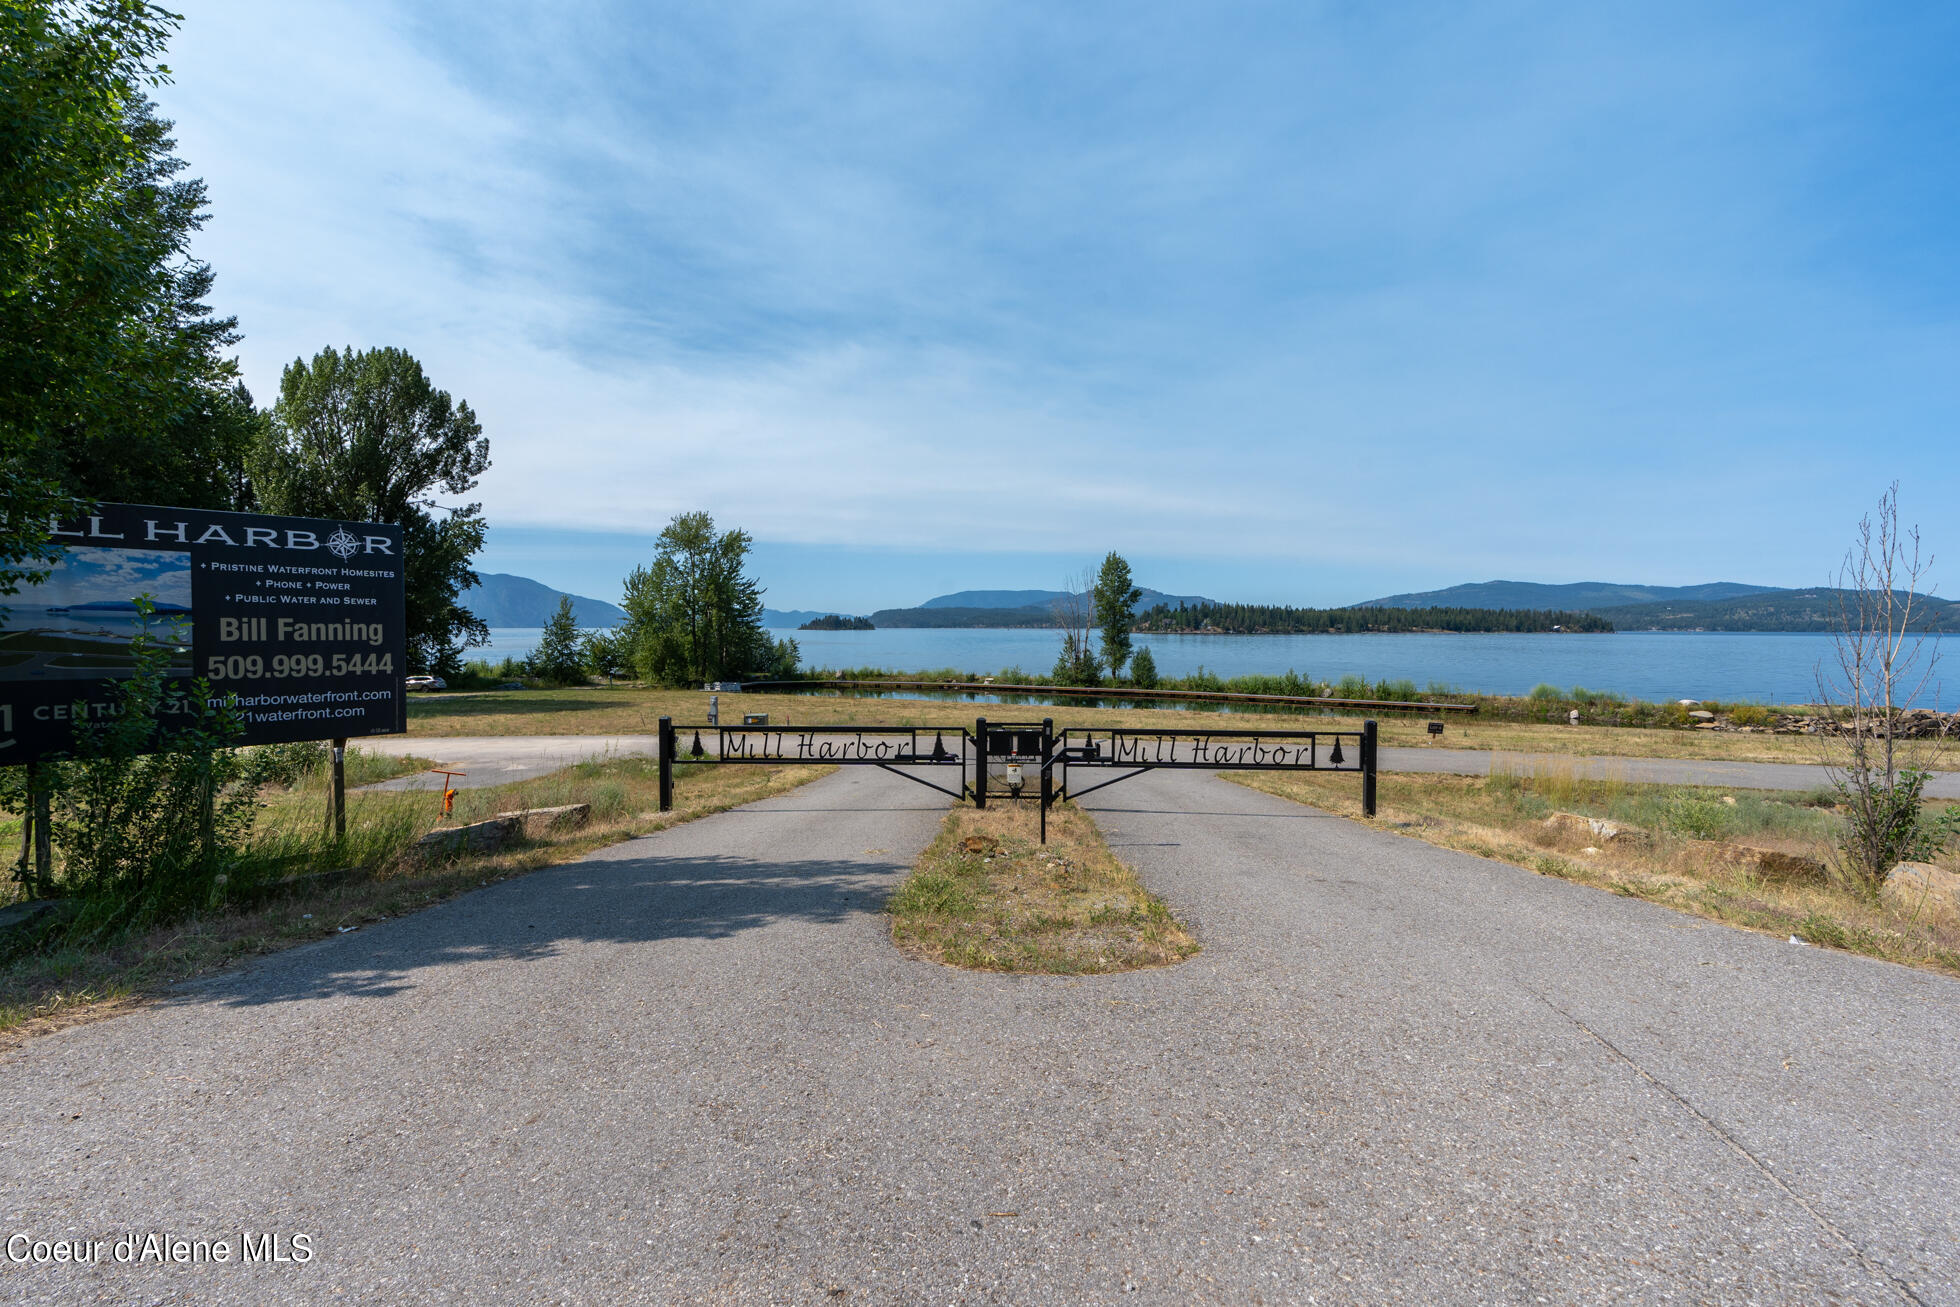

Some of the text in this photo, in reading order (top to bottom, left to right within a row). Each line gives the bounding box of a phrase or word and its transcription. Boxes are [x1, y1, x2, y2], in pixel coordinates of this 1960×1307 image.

[144, 519, 395, 555] HARBOR
[211, 562, 395, 578] PRISTINE WATERFRONT HOMESITES
[265, 579, 351, 591] PHONE POWER
[235, 594, 277, 604] PUBLIC
[280, 595, 317, 605] WATER
[343, 597, 377, 606] SEWER
[220, 617, 383, 646] Bill Fanning
[207, 652, 394, 680] 509.999.5444
[33, 701, 161, 720] CENTUY
[727, 730, 910, 760] Mill Harbor
[1118, 735, 1309, 765] Mill Harbor
